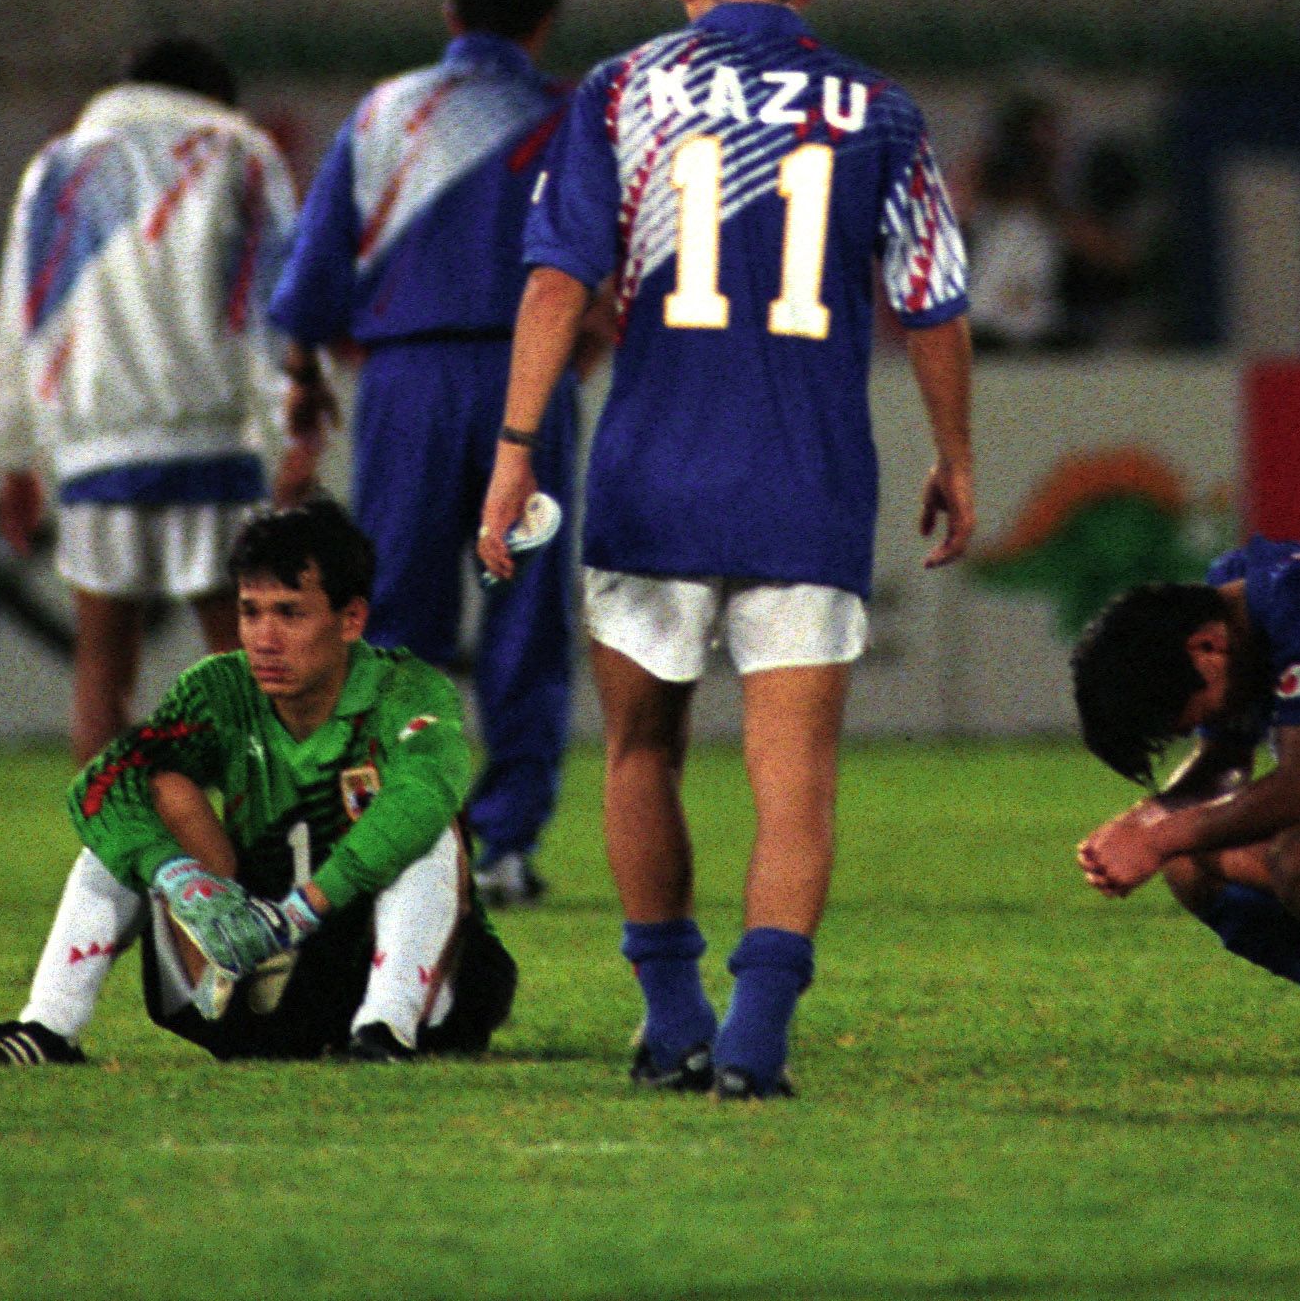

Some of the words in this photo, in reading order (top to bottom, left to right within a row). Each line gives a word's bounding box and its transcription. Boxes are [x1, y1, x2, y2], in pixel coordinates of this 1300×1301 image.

[647, 63, 867, 133] KAZU
[662, 133, 833, 340] 11
[287, 820, 312, 888] 1
